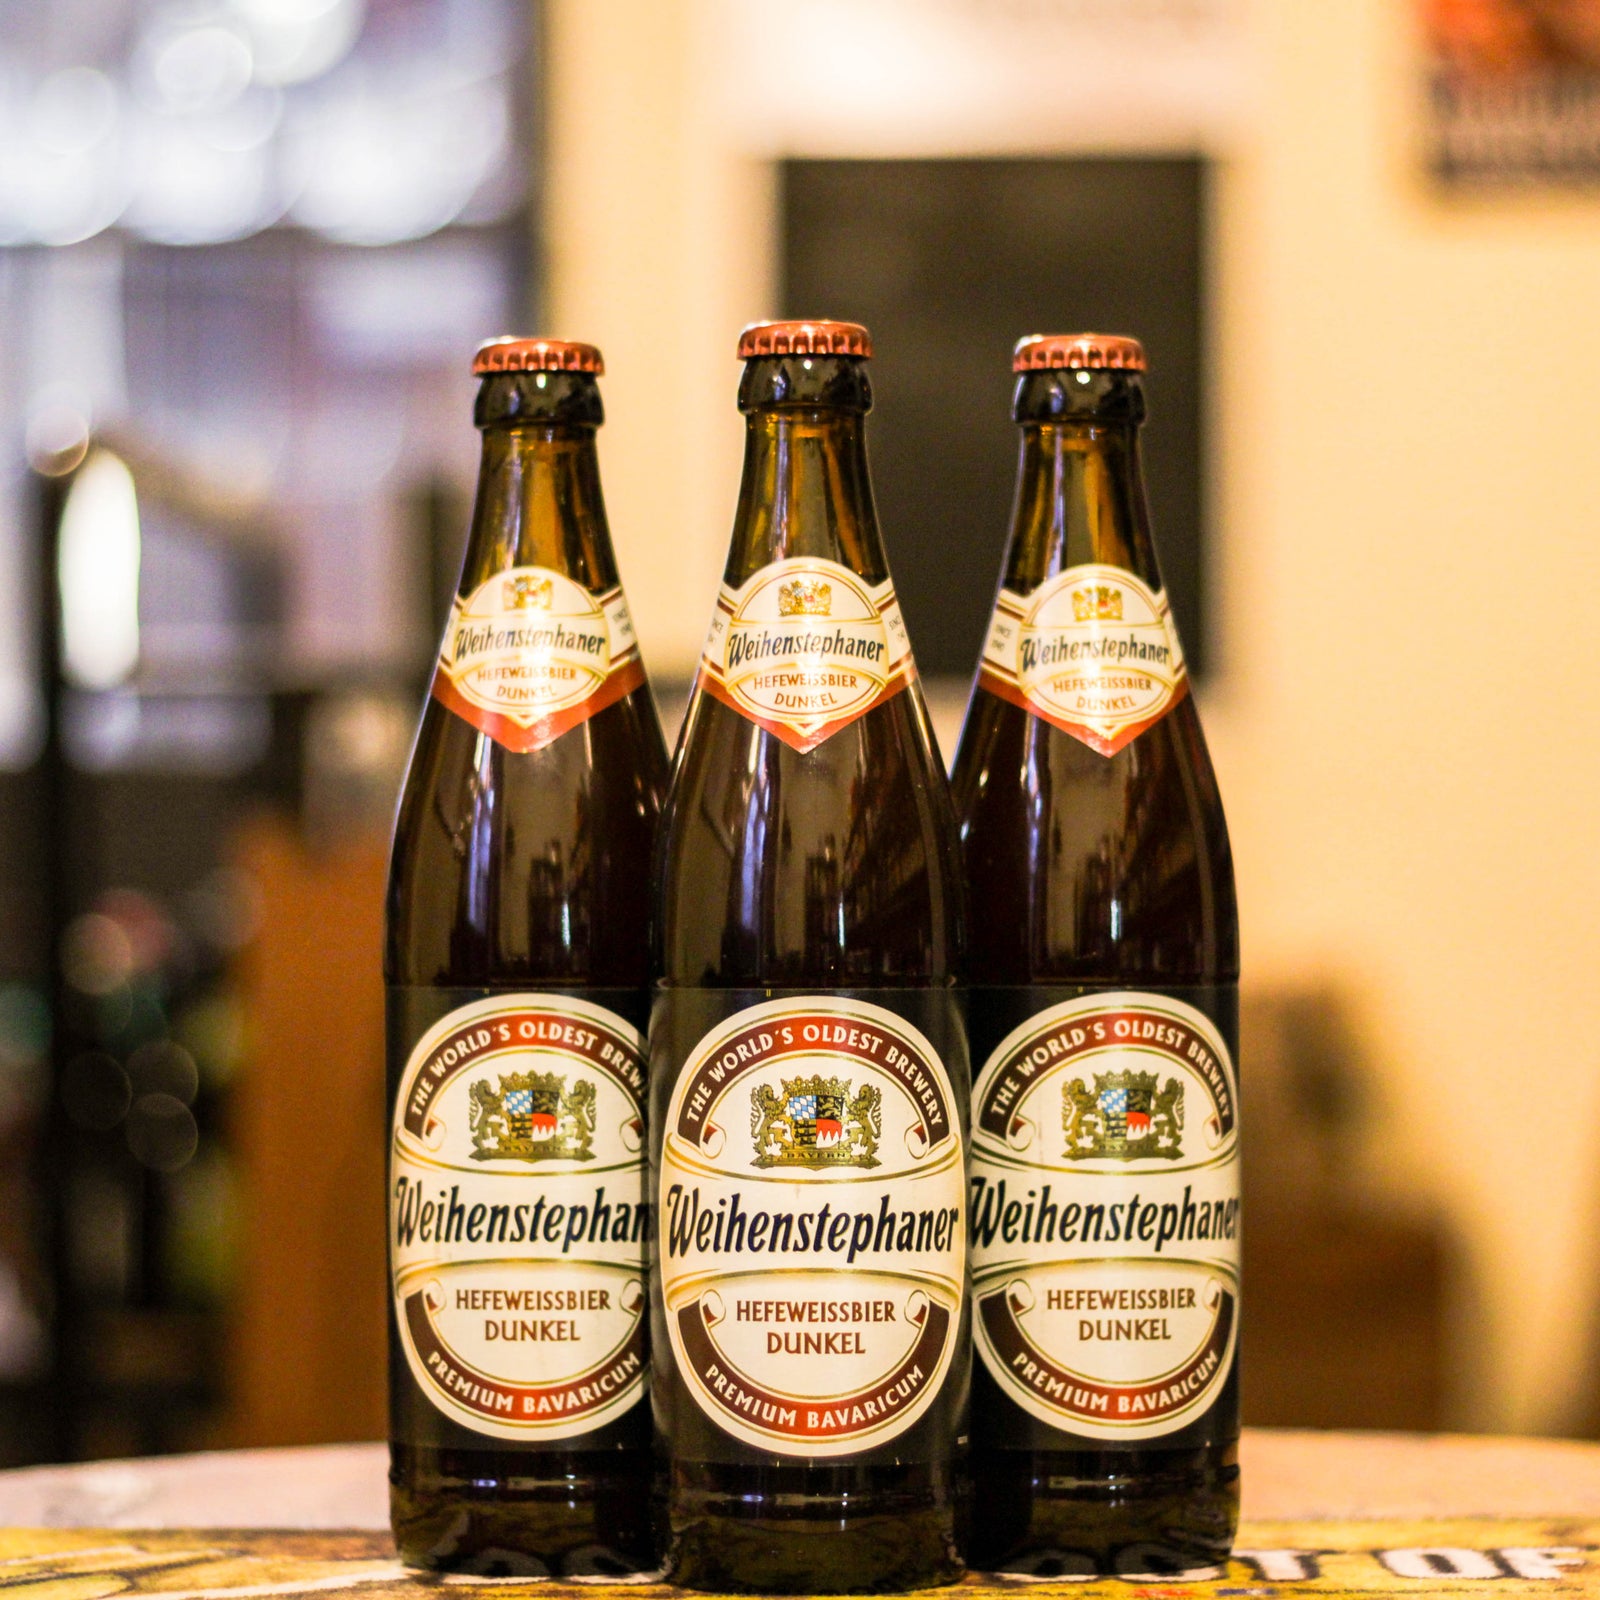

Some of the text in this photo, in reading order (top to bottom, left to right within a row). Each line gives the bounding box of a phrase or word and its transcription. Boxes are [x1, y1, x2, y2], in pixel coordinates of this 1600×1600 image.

[728, 629, 885, 669] Weihenstephaner
[1020, 631, 1170, 672] Weihenstephaner
[754, 674, 858, 690] HEFEWEISSBIER
[774, 693, 838, 708] DUNKEL
[1053, 676, 1153, 694] HEFEWEISSBIER
[1076, 695, 1137, 711] DUNKEL
[412, 1021, 646, 1115] THE WORLD'S OLDEST BREW
[687, 1024, 942, 1126] THE WORLD'S OLDEST BREWERY
[990, 1020, 1230, 1118] THE WORLD'S OLDEST BREWERY
[396, 1176, 649, 1253] Weihenstephan
[667, 1184, 959, 1263] Weihenstephaner
[971, 1176, 1239, 1252] Weihenstephaner
[456, 1289, 611, 1311] HEFEWEISSBIER
[736, 1300, 896, 1323] HEFEWEISSBIER
[1047, 1288, 1196, 1310] HEFEWEISSBIER
[485, 1320, 581, 1341] DUNKEL
[767, 1332, 866, 1355] DUNKEL
[1079, 1319, 1171, 1341] DUNKEL
[427, 1352, 640, 1414] PREMIUM BAVARICUM
[705, 1364, 923, 1429] PREMIUM BAVARICUM
[1013, 1350, 1218, 1414] PREMIUM BAVARICUM
